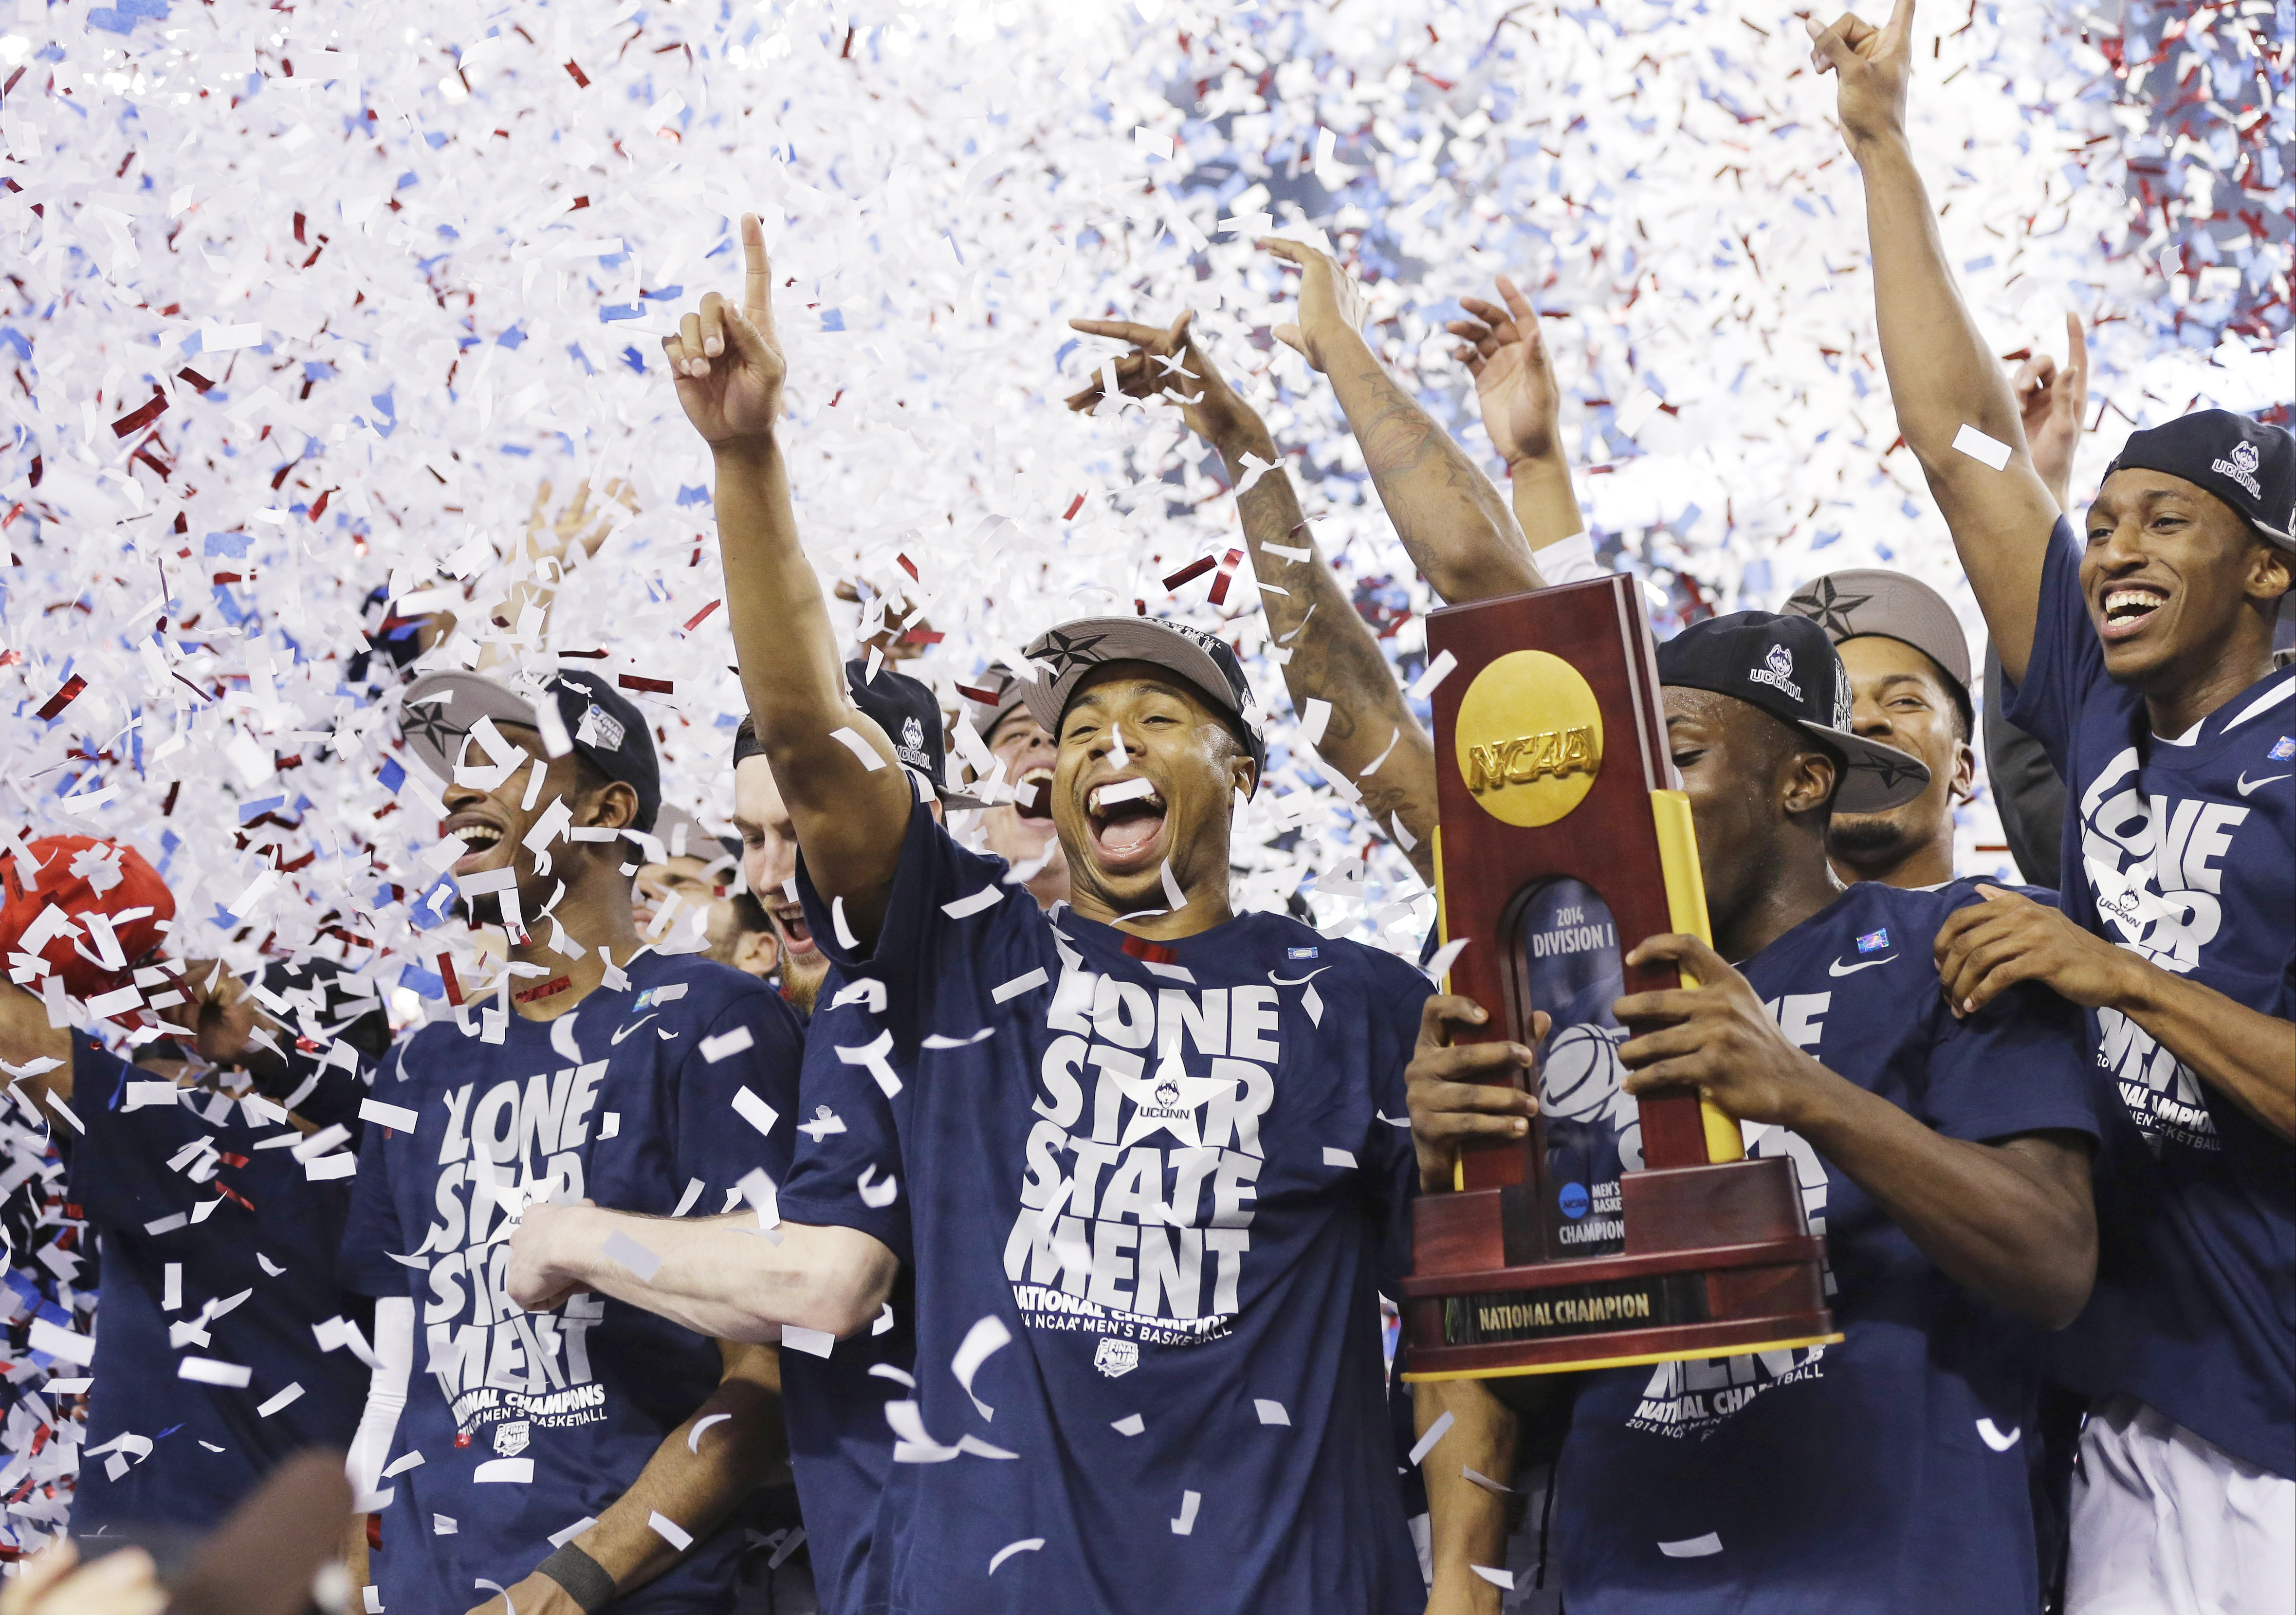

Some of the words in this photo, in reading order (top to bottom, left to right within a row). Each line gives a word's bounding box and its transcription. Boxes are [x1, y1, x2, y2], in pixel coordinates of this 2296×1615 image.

[2211, 459, 2261, 500] UCONN
[1749, 668, 1803, 702] UCONN
[1469, 725, 1596, 794] NCAA
[1557, 907, 1584, 927] 2014
[2099, 898, 2141, 927] UCONN
[1533, 924, 1604, 958] DIVISION
[1607, 923, 1614, 947] I
[1047, 966, 1280, 1064] LONE
[438, 1059, 609, 1165] LONE
[1140, 1106, 1190, 1120] UCONN
[1020, 1120, 1262, 1228] STATE
[1592, 1180, 1620, 1198] MEN'S
[1559, 1220, 1624, 1245] CHAMPION
[1003, 1207, 1249, 1319] MENT
[1479, 1302, 1553, 1331] NATIONAL
[1555, 1292, 1650, 1323] CHAMPION
[1083, 1318, 1134, 1337] MEN'S
[426, 1314, 603, 1405] MENT
[1096, 1347, 1136, 1365] FOUR
[1109, 1341, 1136, 1354] FINAL
[483, 1407, 525, 1423] MEN'S
[1625, 1418, 1658, 1433] 2014
[496, 1432, 528, 1447] FOUR
[505, 1425, 528, 1435] FINAL
